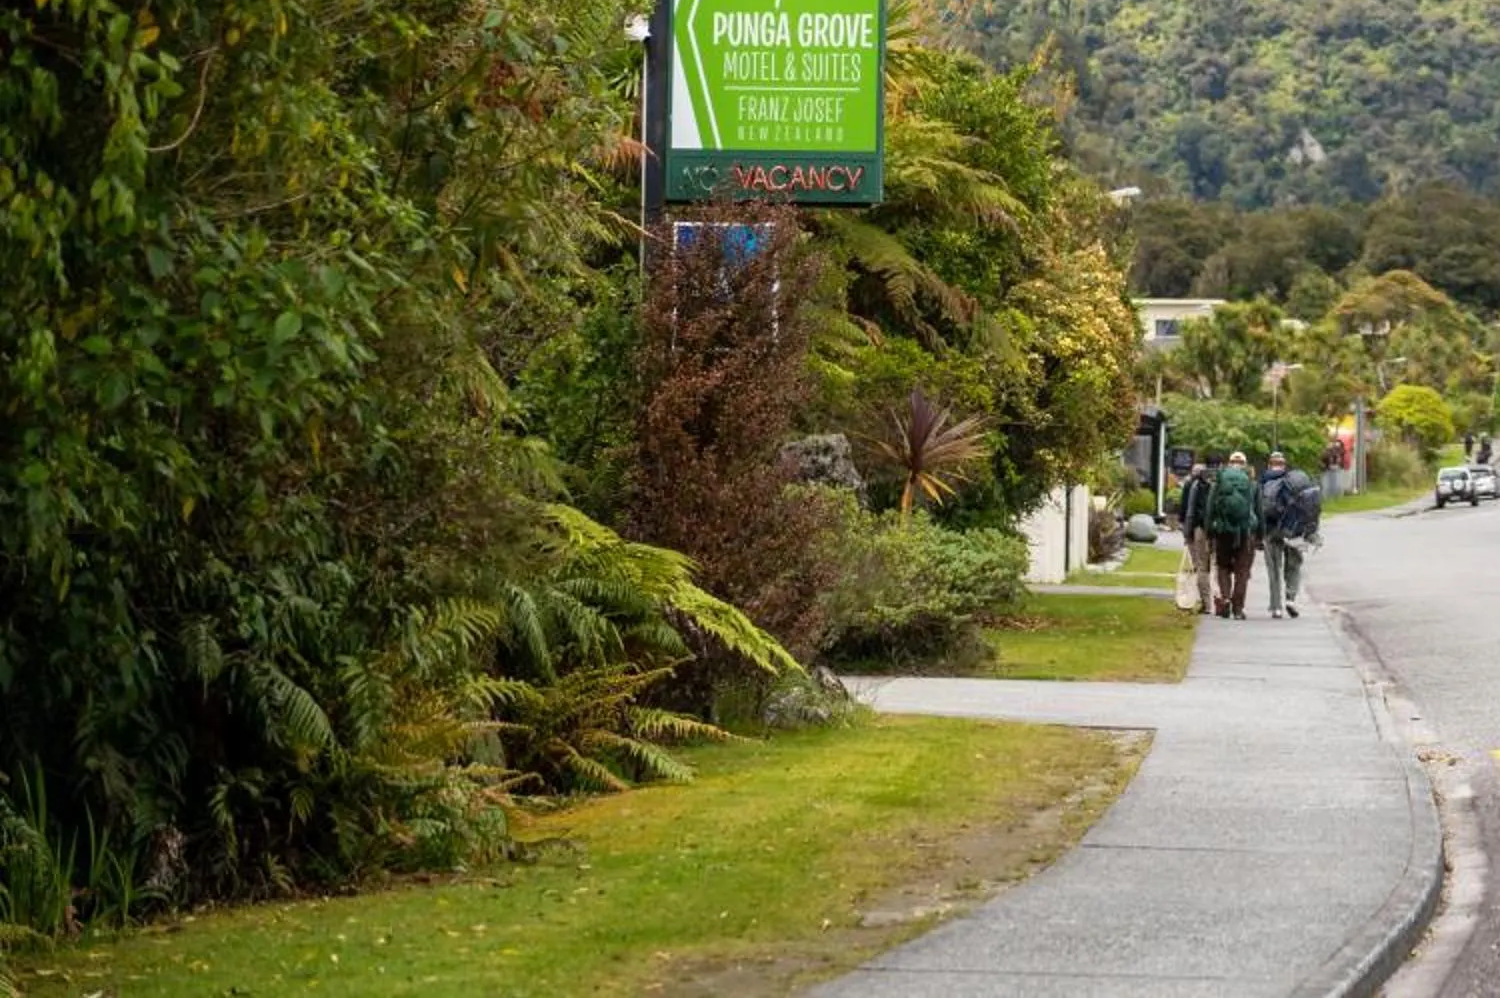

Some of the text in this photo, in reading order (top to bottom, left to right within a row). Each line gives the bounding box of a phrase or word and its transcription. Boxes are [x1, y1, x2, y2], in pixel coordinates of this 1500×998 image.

[713, 11, 873, 48] PUNGA GROVE
[724, 51, 861, 82] MOTEL & SUITES
[738, 96, 845, 123] FRANZ JOSEF
[737, 126, 844, 142] NEW ZEALAND
[736, 164, 865, 191] VACANCY
